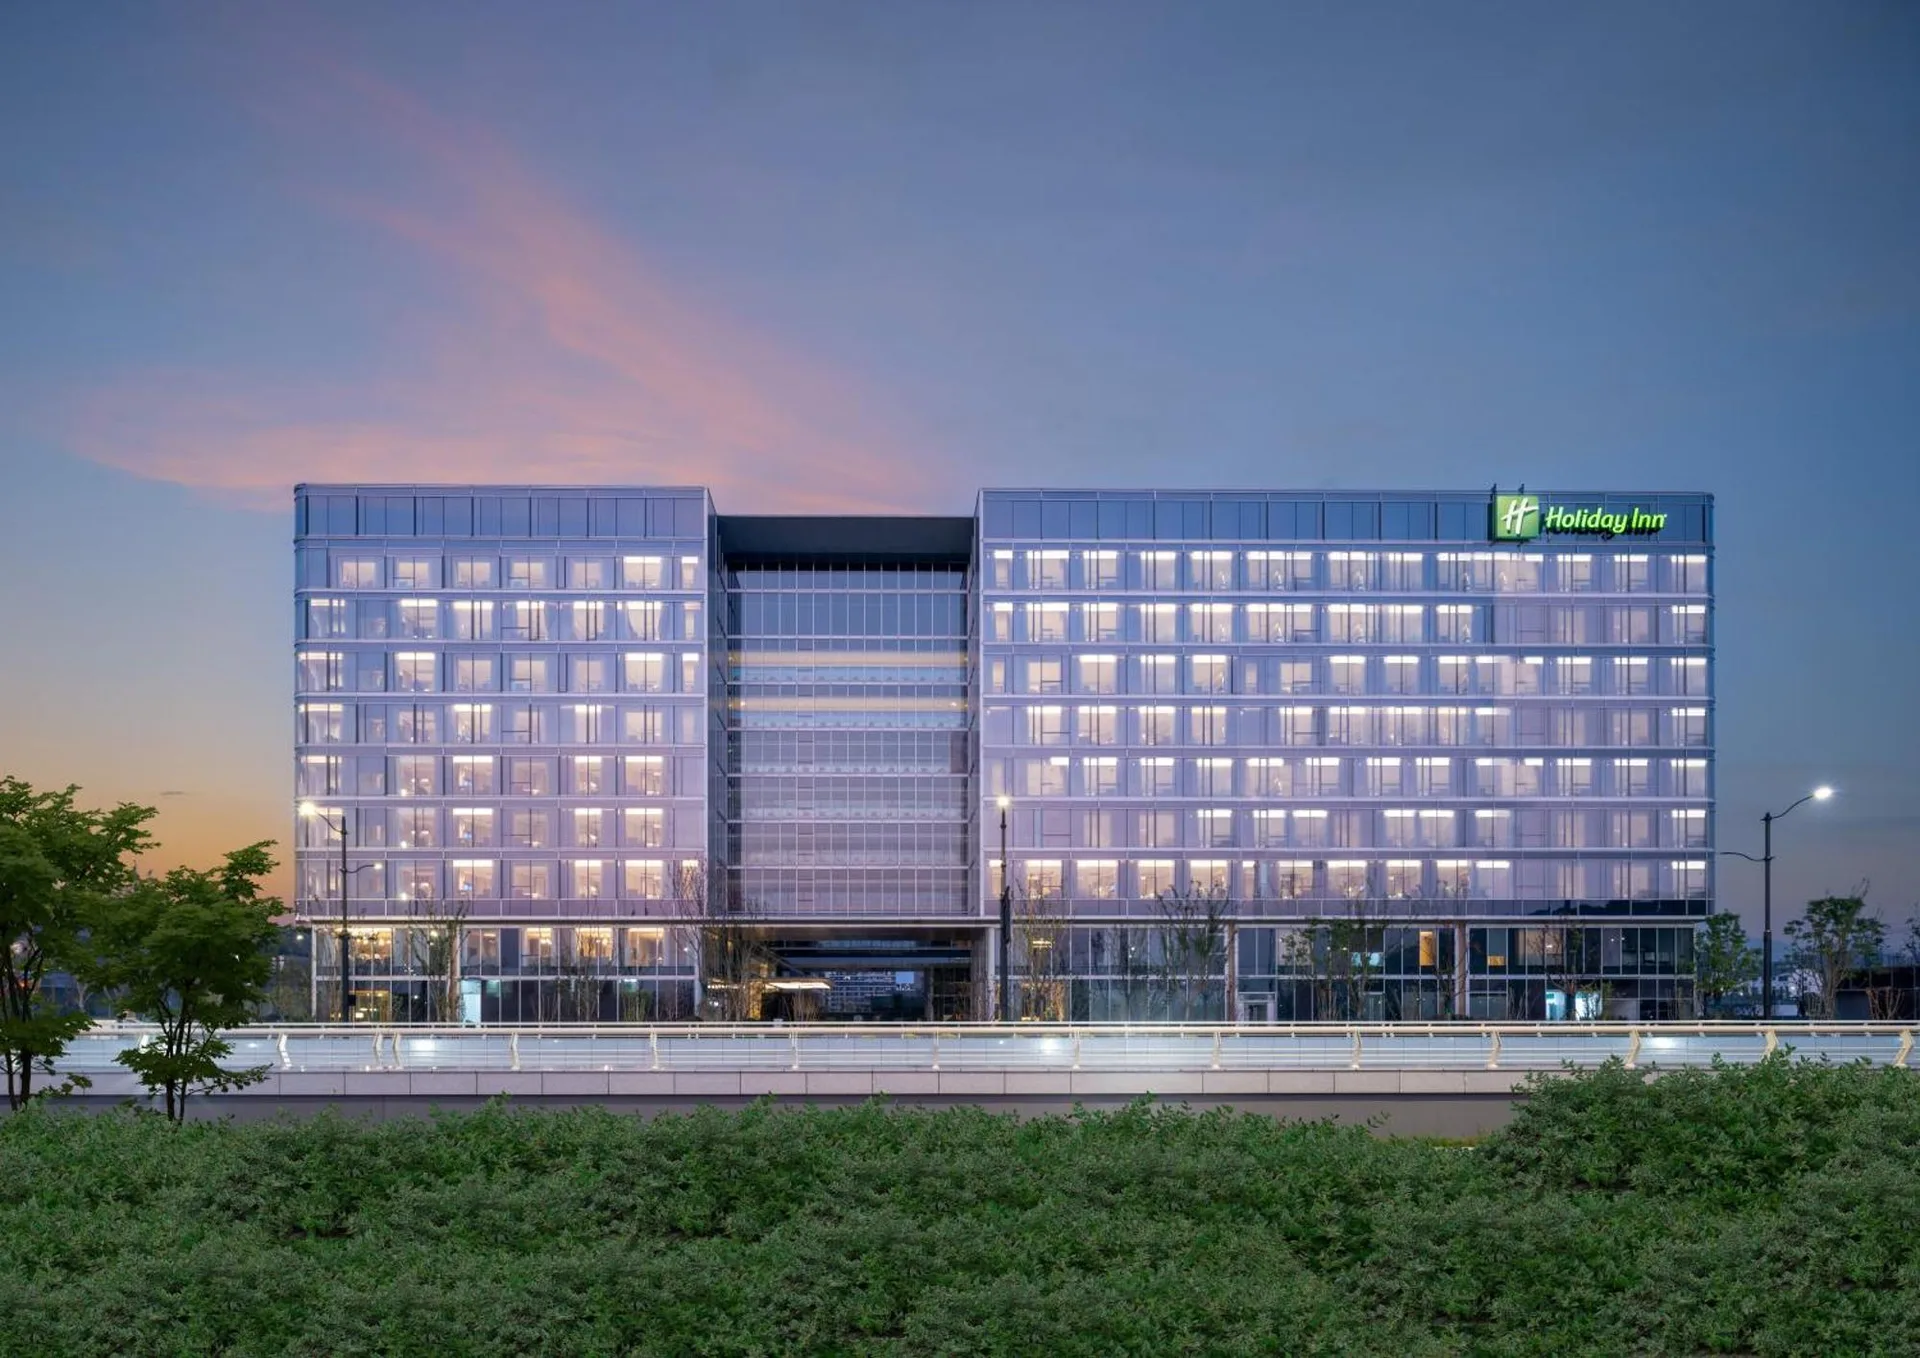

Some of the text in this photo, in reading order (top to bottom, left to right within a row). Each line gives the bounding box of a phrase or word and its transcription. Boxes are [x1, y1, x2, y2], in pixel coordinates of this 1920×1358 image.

[1501, 497, 1539, 535] H
[1545, 506, 1665, 533] Holiday Inn
